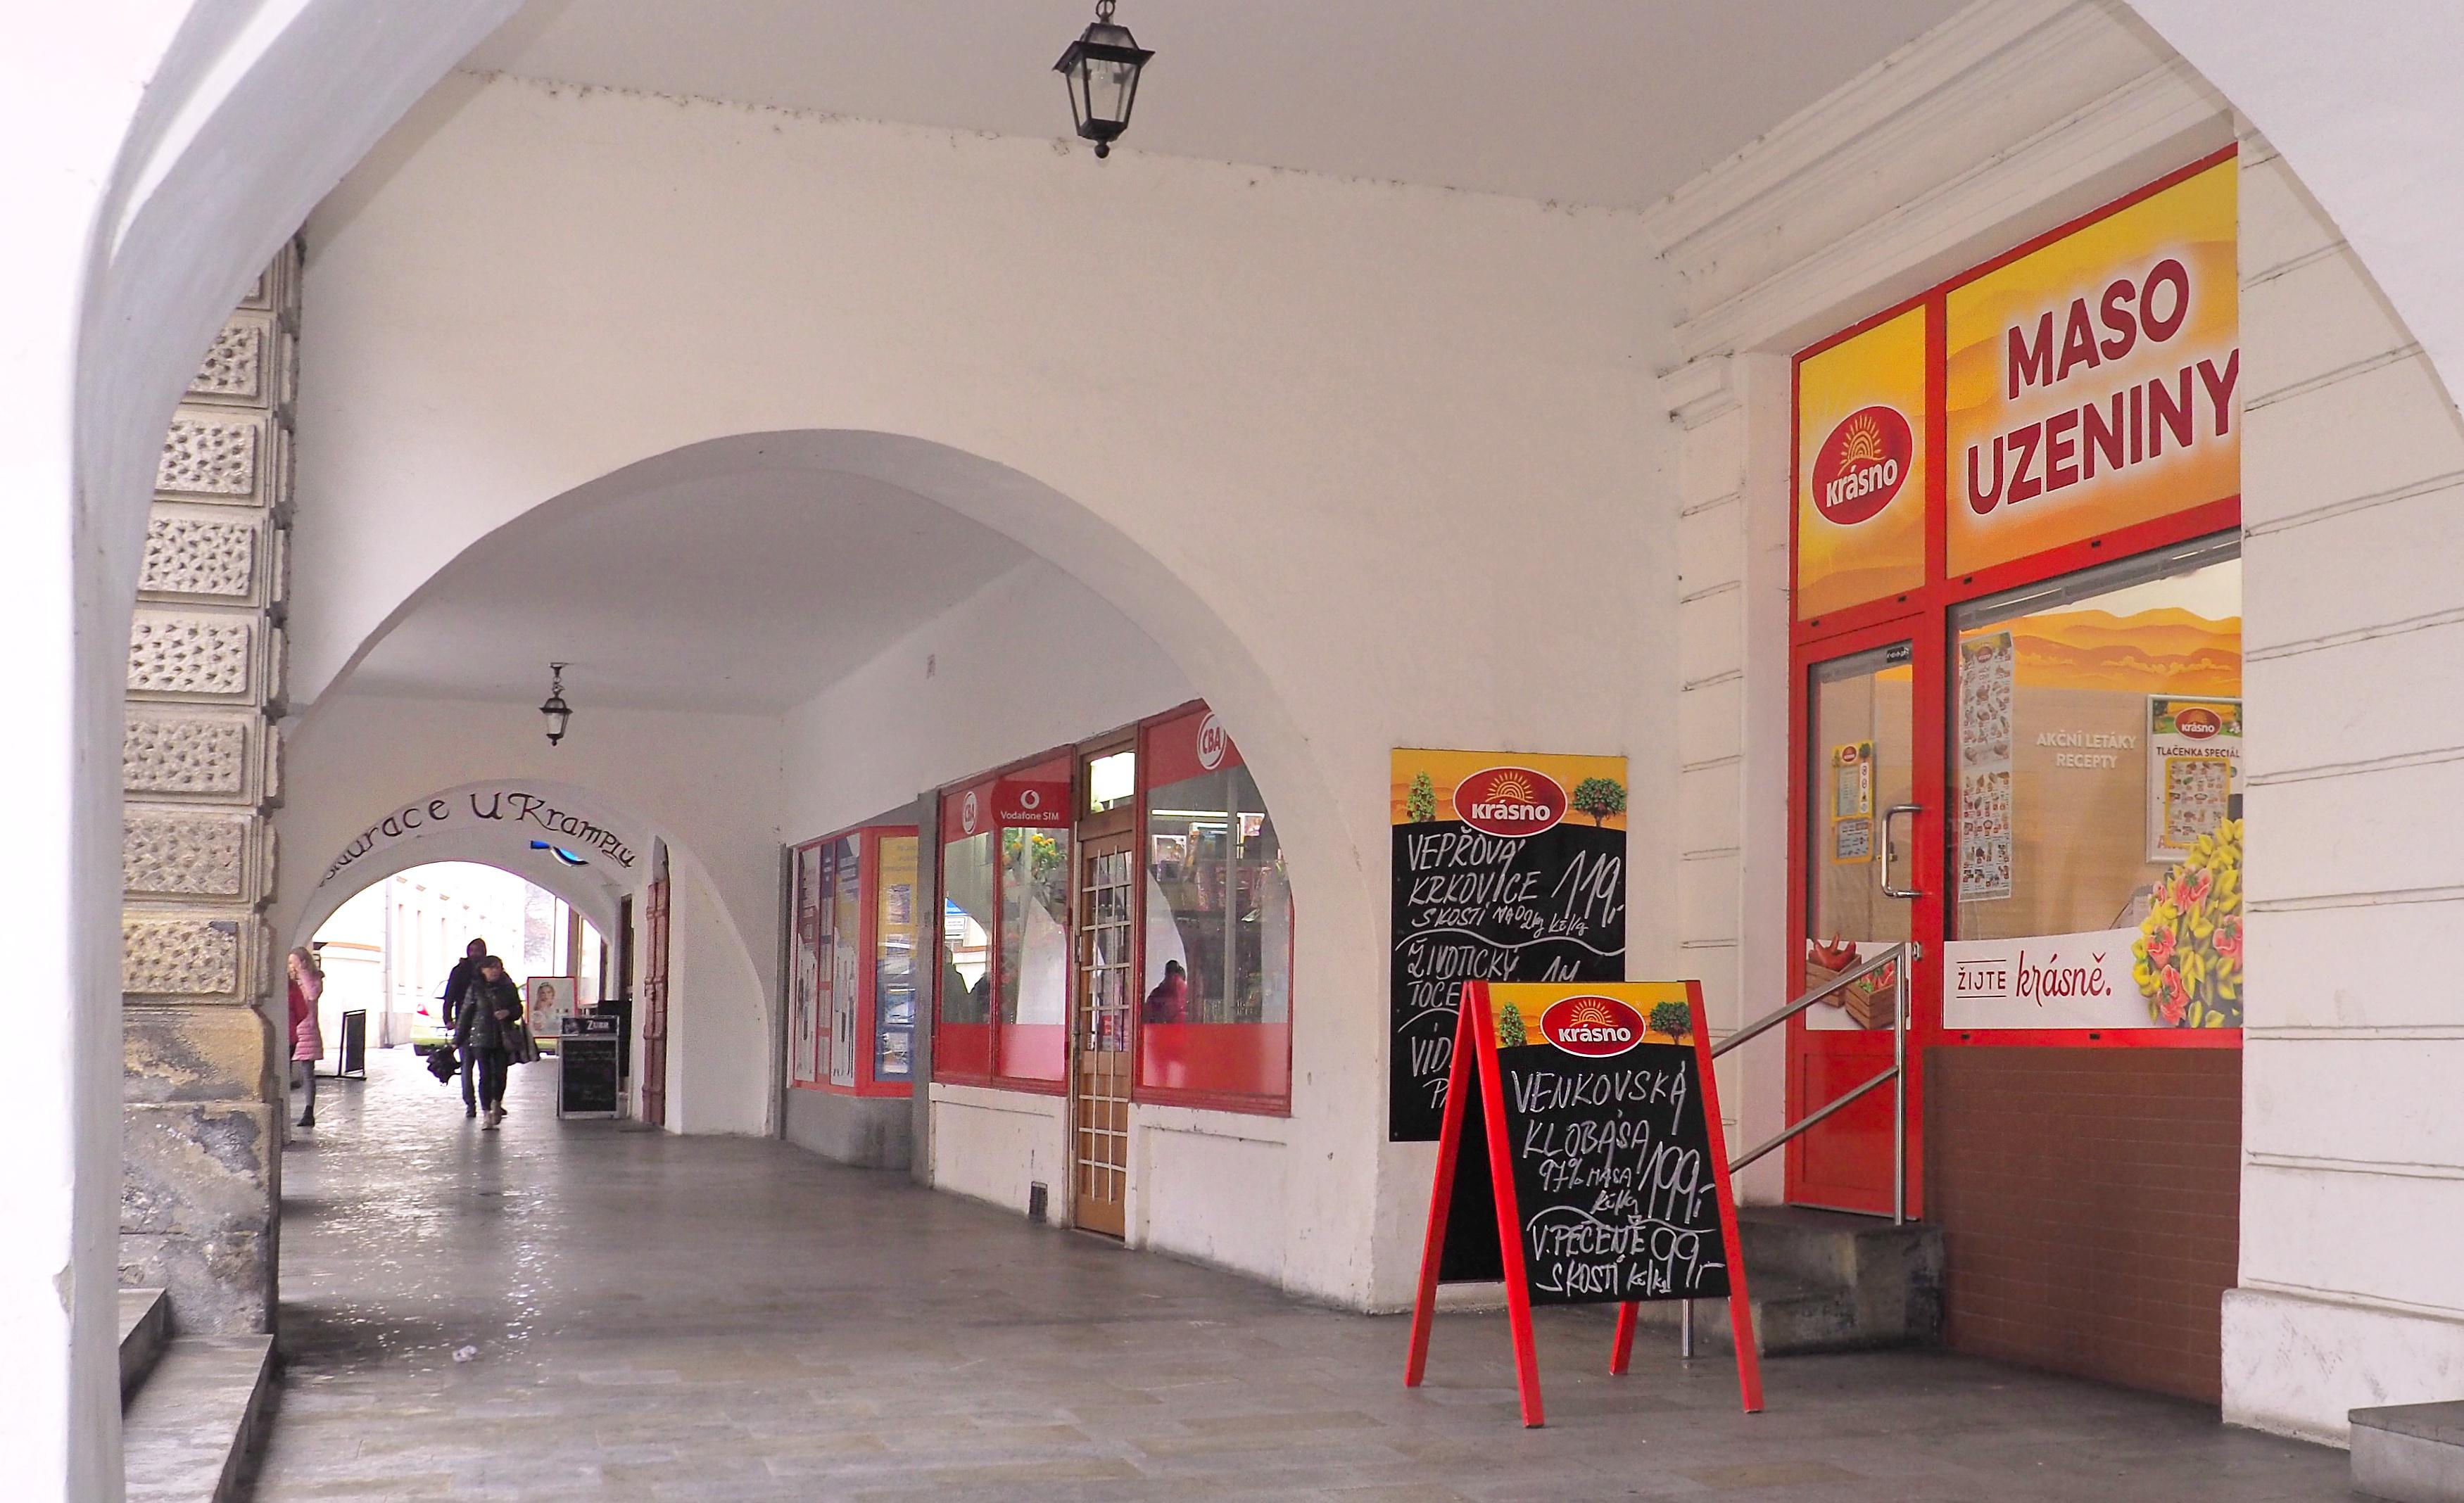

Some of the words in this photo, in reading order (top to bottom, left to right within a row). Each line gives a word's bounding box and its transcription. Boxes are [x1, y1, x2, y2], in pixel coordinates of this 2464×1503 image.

[2008, 258, 2190, 401] MASO
[1968, 348, 2239, 516] UZENINY
[2037, 729, 2082, 748] AKČNÍ
[2085, 731, 2137, 750] LETÁKY
[2156, 744, 2203, 757] TLAČENKA
[2204, 747, 2239, 758] SPECIÁL
[2056, 753, 2118, 769] RECEPTY
[469, 792, 504, 820] U
[1000, 810, 1042, 821] Vodafone
[1043, 811, 1059, 821] SIM
[1407, 825, 1526, 873] VEPŘOVÁ
[1408, 870, 1541, 907] KRKOVICE
[1408, 975, 1462, 1008] TOČE
[1957, 966, 2006, 991] ŽIJTE
[2015, 950, 2111, 1008] krásně.
[1510, 1060, 1686, 1135] VENKOVSKÁ
